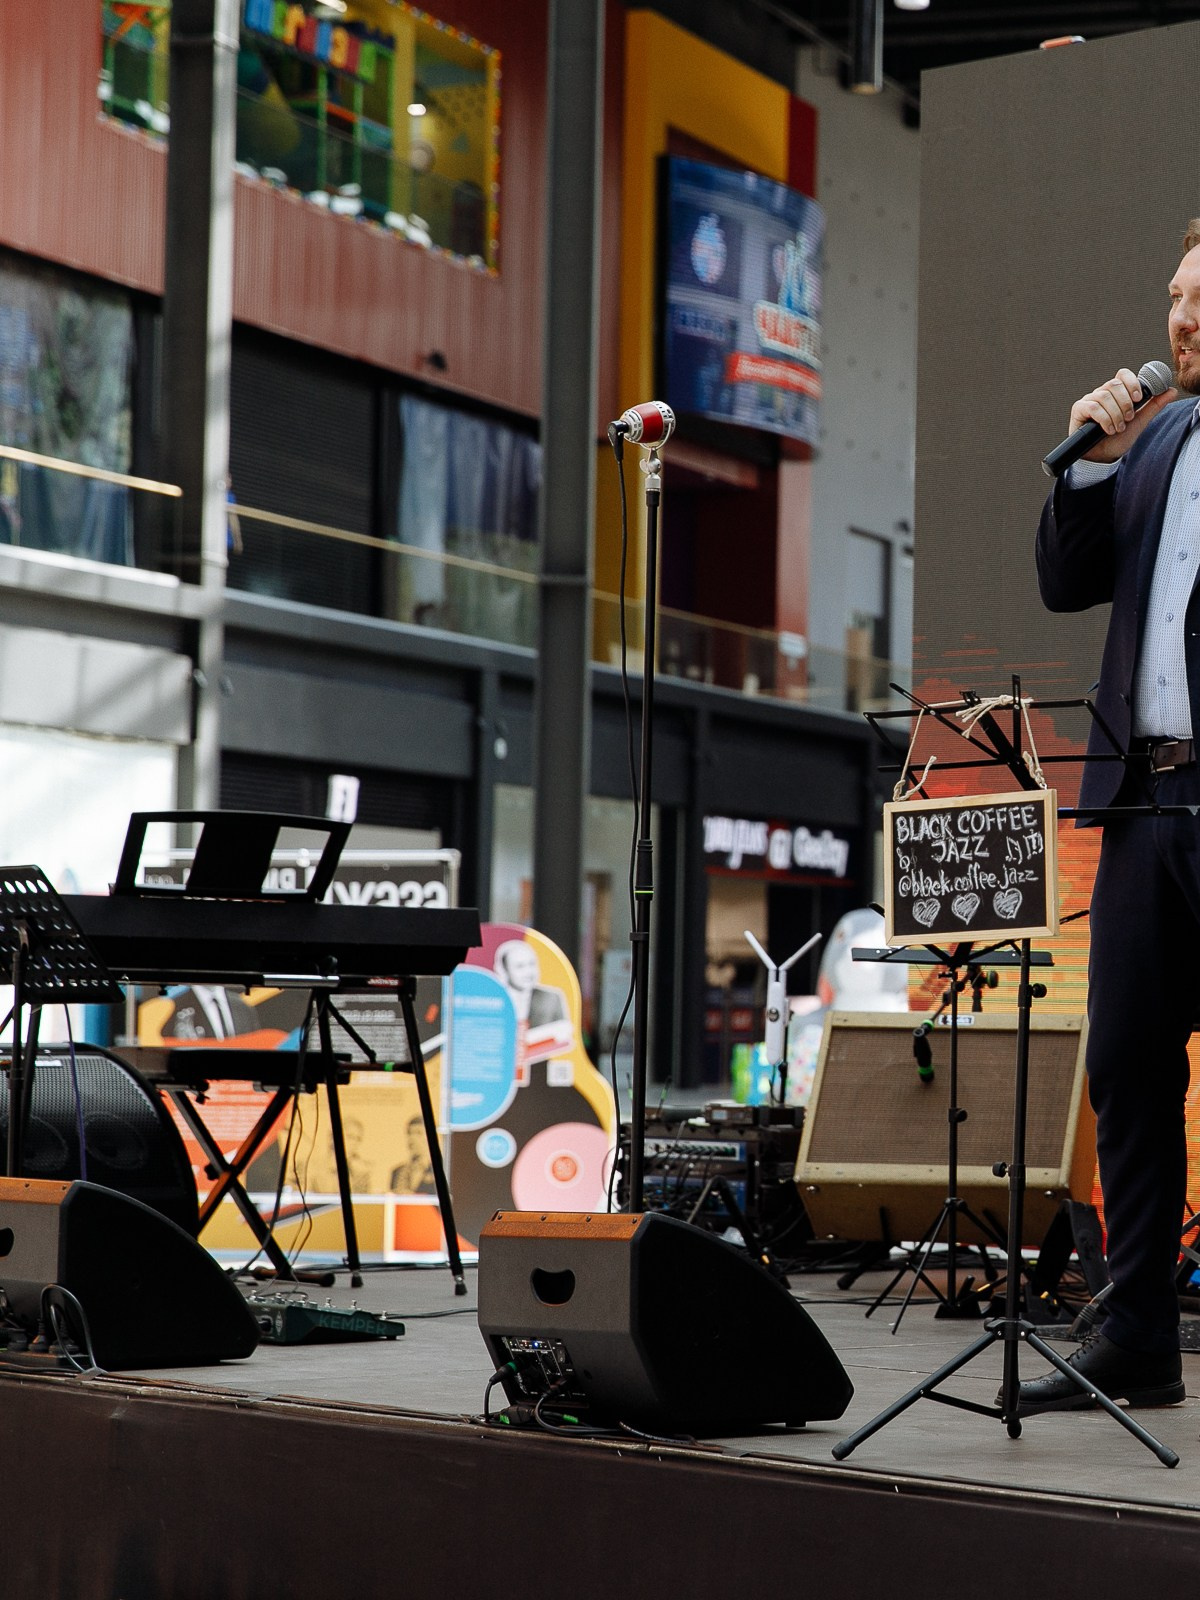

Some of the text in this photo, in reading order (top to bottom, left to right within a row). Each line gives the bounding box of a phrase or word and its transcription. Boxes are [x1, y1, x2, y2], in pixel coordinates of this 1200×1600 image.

[896, 805, 1037, 844] BLACK COFFEE
[931, 835, 989, 863] JAZZ
[899, 862, 1039, 898] @black.coffee.jazz
[319, 1314, 387, 1335] KEMPER
